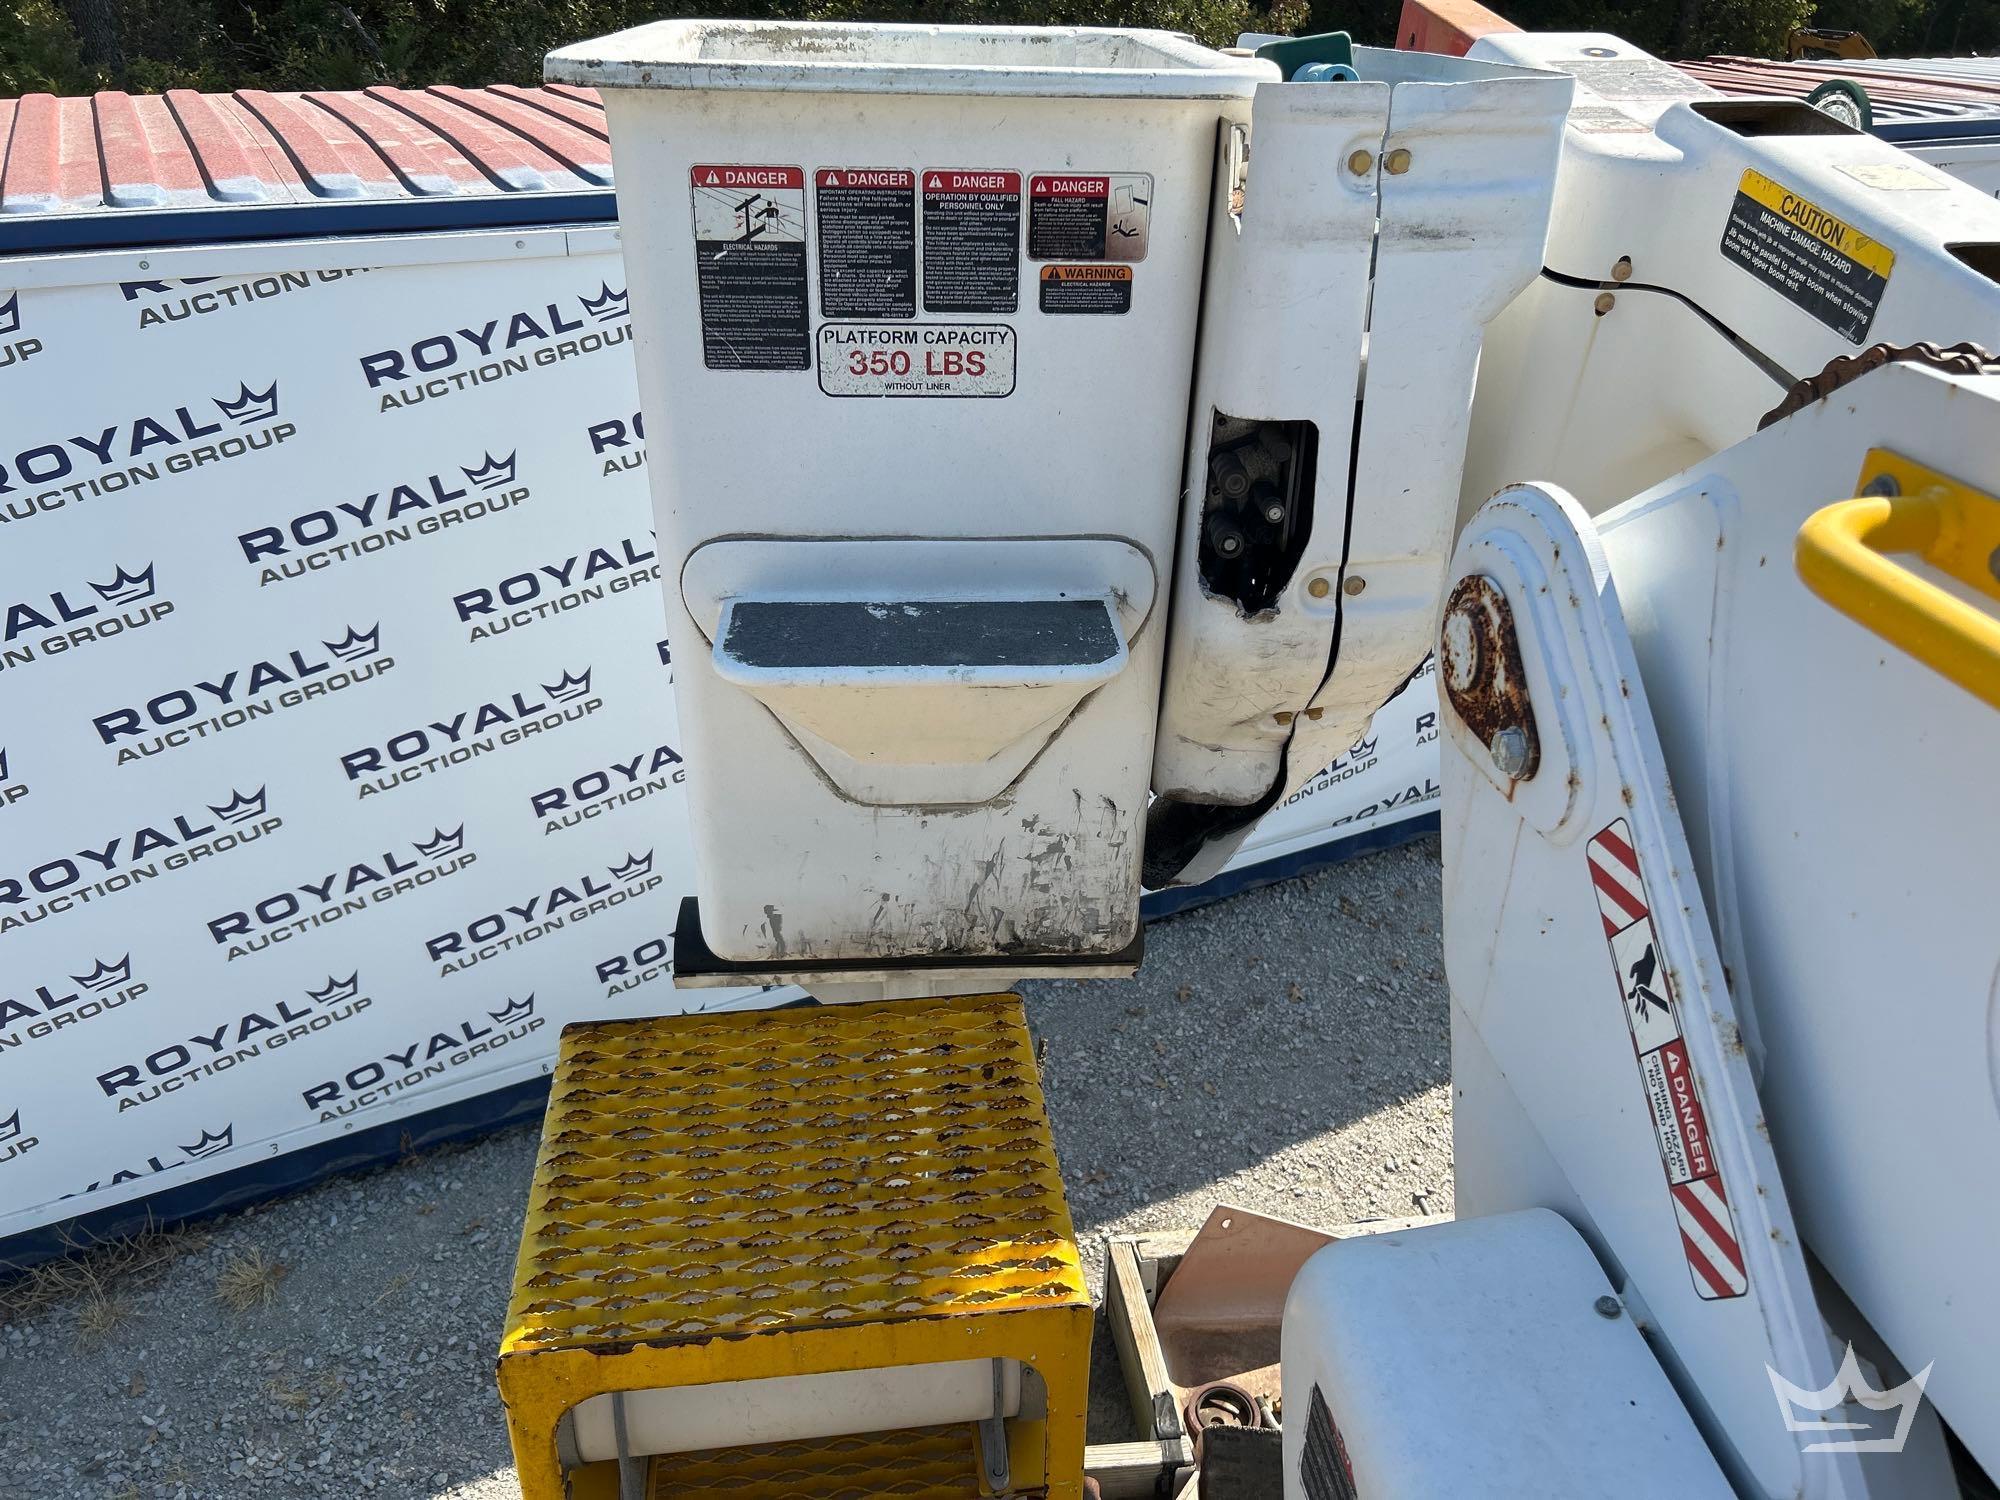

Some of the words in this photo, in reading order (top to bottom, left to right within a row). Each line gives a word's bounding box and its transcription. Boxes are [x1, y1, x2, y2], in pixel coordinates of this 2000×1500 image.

[725, 171, 788, 185] DANGER
[848, 173, 908, 186] DANGER
[925, 193, 967, 201] OPERATION
[980, 194, 1018, 202] QUALIFIED
[939, 202, 983, 210] PERSONNEL
[953, 175, 1005, 189] DANGER
[1052, 180, 1104, 193] DANGER
[1781, 194, 1846, 246] CAUTION
[1065, 268, 1126, 280] WARNING
[1725, 236, 1740, 252] boom
[1740, 246, 1751, 259] into
[1752, 256, 1768, 270] upper
[1768, 265, 1785, 282] boom
[1737, 234, 1751, 246] must
[1752, 241, 1759, 252] be
[1759, 249, 1781, 266] parallel
[1781, 261, 1787, 270] to
[1789, 268, 1806, 283] upper
[1807, 277, 1824, 295] boom
[1825, 290, 1841, 306] when
[1842, 302, 1868, 324] stowing
[1760, 212, 1790, 237] MACHINE
[1790, 230, 1819, 256] DAMAGE
[1821, 248, 1852, 274] HAZARD
[140, 270, 311, 329] AUCTION
[824, 330, 918, 344] PLATFORM
[924, 331, 1009, 344] CAPACITY
[360, 302, 584, 388] ROYAL
[381, 355, 528, 413] AUCTION
[850, 350, 910, 376] 350
[926, 351, 986, 376] LBS
[165, 423, 296, 473] GROUP
[238, 475, 467, 564] ROYAL
[261, 526, 411, 587] AUCTION
[417, 488, 529, 534] GROUP
[453, 539, 654, 622] ROYAL
[471, 585, 604, 643] AUCTION
[41, 601, 174, 655] GROUP
[92, 651, 329, 744] ROYAL
[118, 700, 273, 766] AUCTION
[279, 658, 394, 707] GROUP
[340, 693, 546, 780] ROYAL
[360, 738, 495, 799] AUCTION
[501, 699, 602, 745] GROUP
[1317, 757, 1378, 791] GROUP
[545, 778, 667, 835] AUCTION
[0, 816, 216, 904] ROYAL
[1, 864, 159, 933] AUCTION
[164, 818, 282, 870] GROUP
[207, 852, 418, 944] ROYAL
[228, 896, 367, 961] AUCTION
[372, 853, 476, 902] GROUP
[425, 876, 611, 961] ROYAL
[441, 917, 564, 977] AUCTION
[570, 876, 662, 922] GROUP
[27, 983, 148, 1038] GROUP
[96, 1001, 312, 1097] ROYAL
[119, 1044, 261, 1113] AUCTION
[266, 998, 372, 1049] GROUP
[302, 1021, 492, 1110] ROYAL
[320, 1061, 446, 1123] AUCTION
[450, 1015, 545, 1066] GROUP
[1647, 1069, 1656, 1088] NO
[1654, 1092, 1666, 1127] HAND
[1664, 1132, 1676, 1166] HOLD
[1651, 1055, 1672, 1120] CRUSHING
[1669, 1124, 1686, 1177] HAZARD
[1674, 1076, 1707, 1174] DANGER
